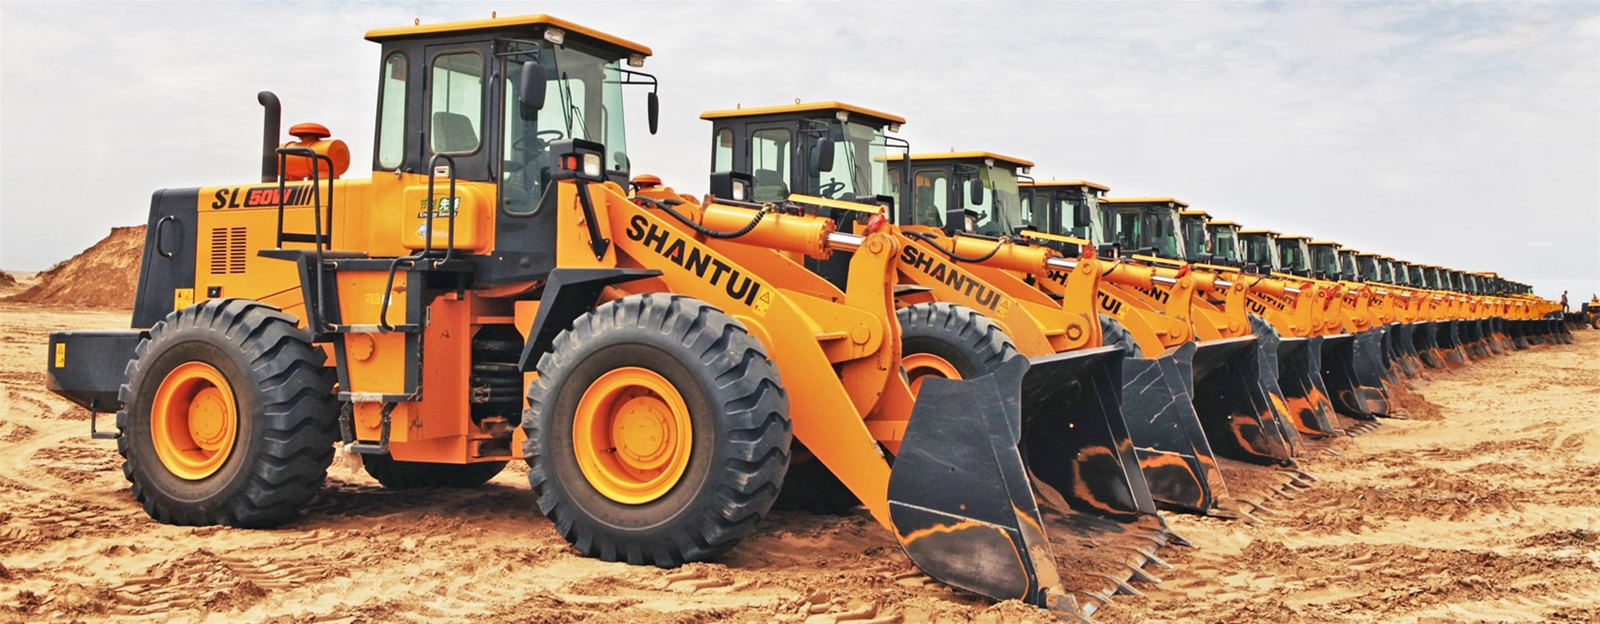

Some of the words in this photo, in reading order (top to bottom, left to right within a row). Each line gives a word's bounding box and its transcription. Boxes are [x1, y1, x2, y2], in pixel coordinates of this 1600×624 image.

[212, 188, 241, 210] SL
[248, 188, 293, 206] 50W
[626, 214, 761, 307] SHANTUI
[900, 244, 1001, 311] SHANTUI
